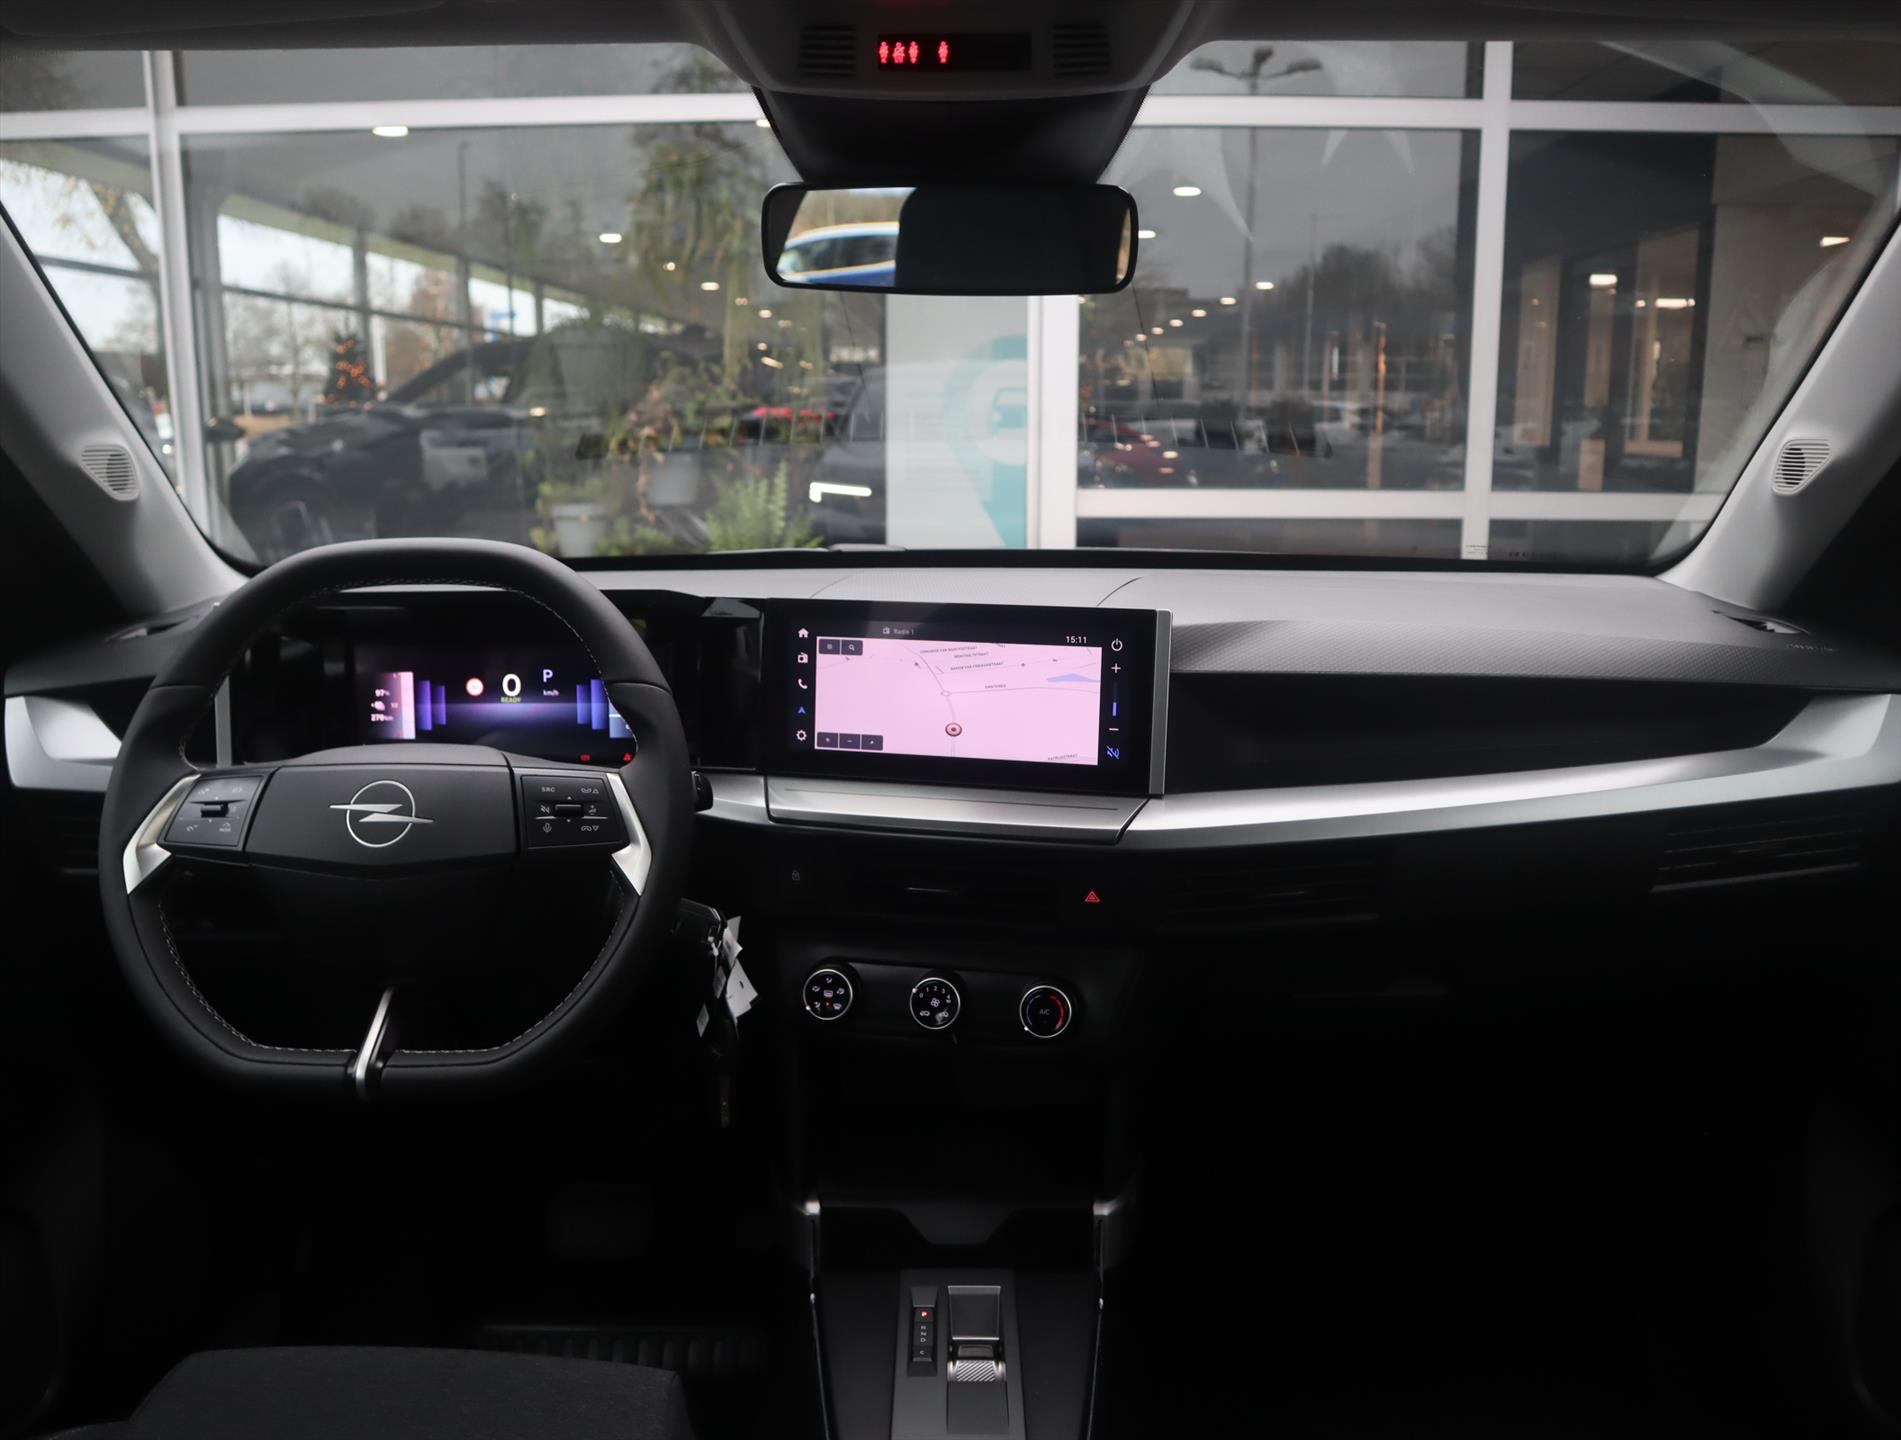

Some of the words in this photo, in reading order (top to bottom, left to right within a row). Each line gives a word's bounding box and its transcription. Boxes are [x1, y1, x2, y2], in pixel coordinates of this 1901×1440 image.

[1066, 635, 1088, 644] 15:11
[543, 669, 553, 683] P
[502, 673, 522, 697] 0
[1039, 1007, 1051, 1016] A/C
